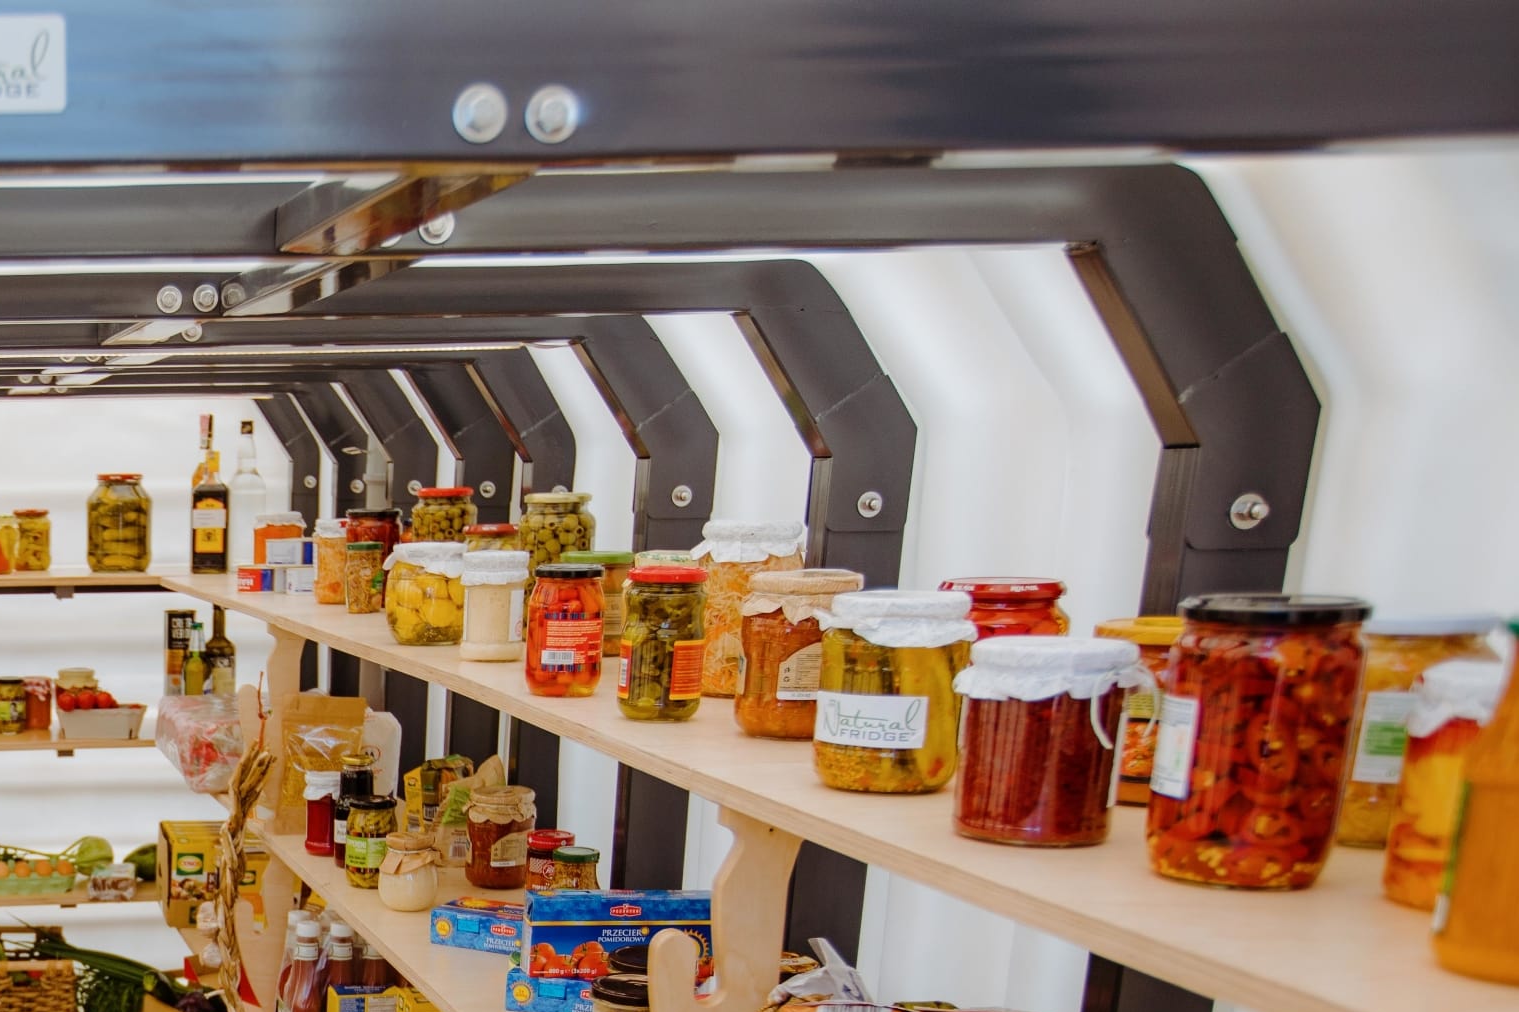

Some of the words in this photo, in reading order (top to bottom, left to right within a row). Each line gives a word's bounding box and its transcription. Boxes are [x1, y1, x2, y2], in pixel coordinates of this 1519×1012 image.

[822, 699, 922, 737] Natural
[839, 729, 912, 743] FRIDGE
[601, 928, 643, 937] PRZECIER
[574, 1002, 593, 1012] PRZE
